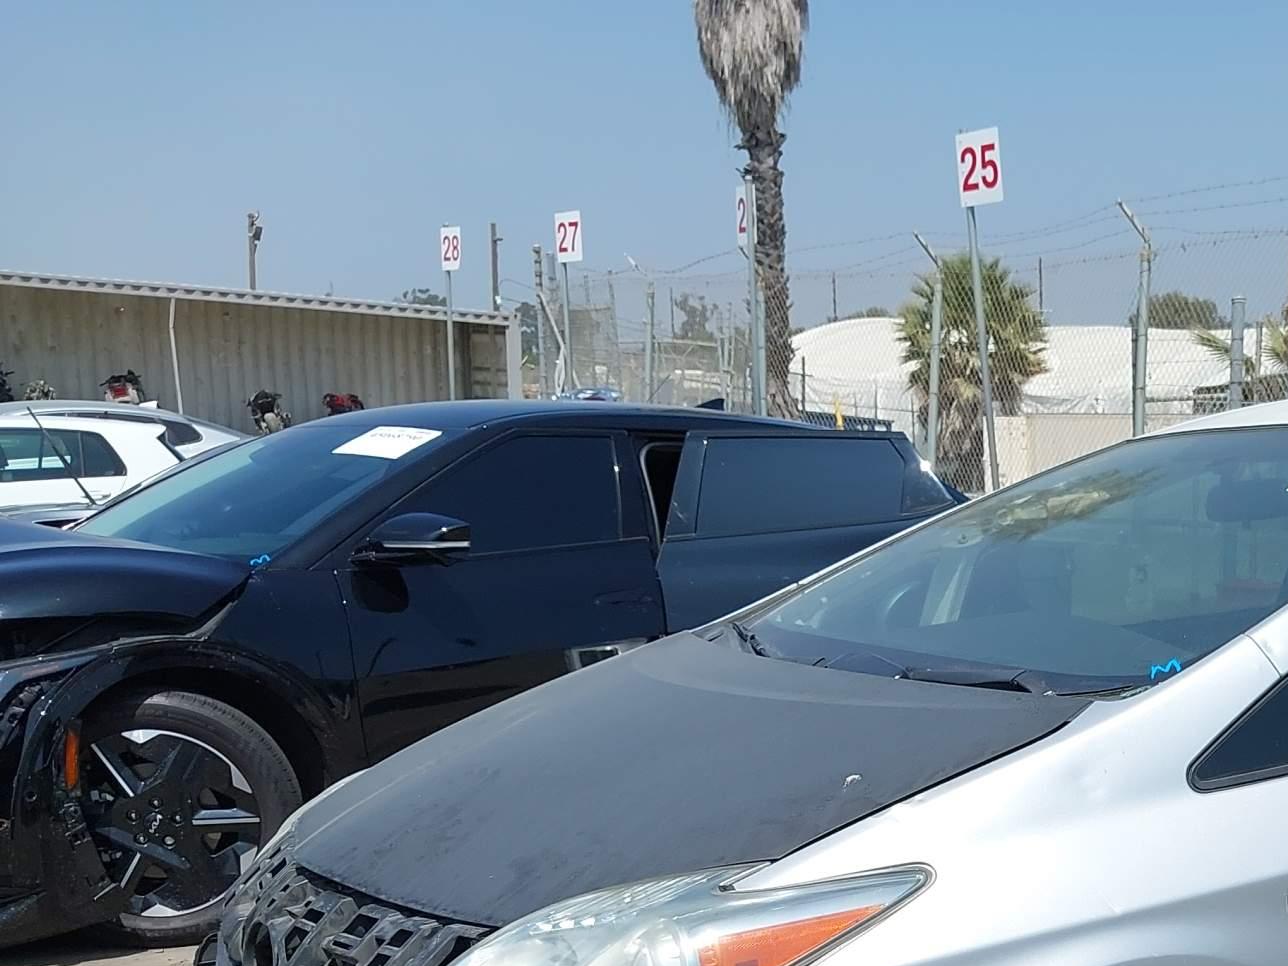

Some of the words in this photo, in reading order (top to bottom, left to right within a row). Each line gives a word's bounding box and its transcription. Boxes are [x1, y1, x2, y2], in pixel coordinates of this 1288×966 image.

[960, 143, 998, 192] 25
[443, 235, 459, 261] 28
[558, 221, 578, 253] 27
